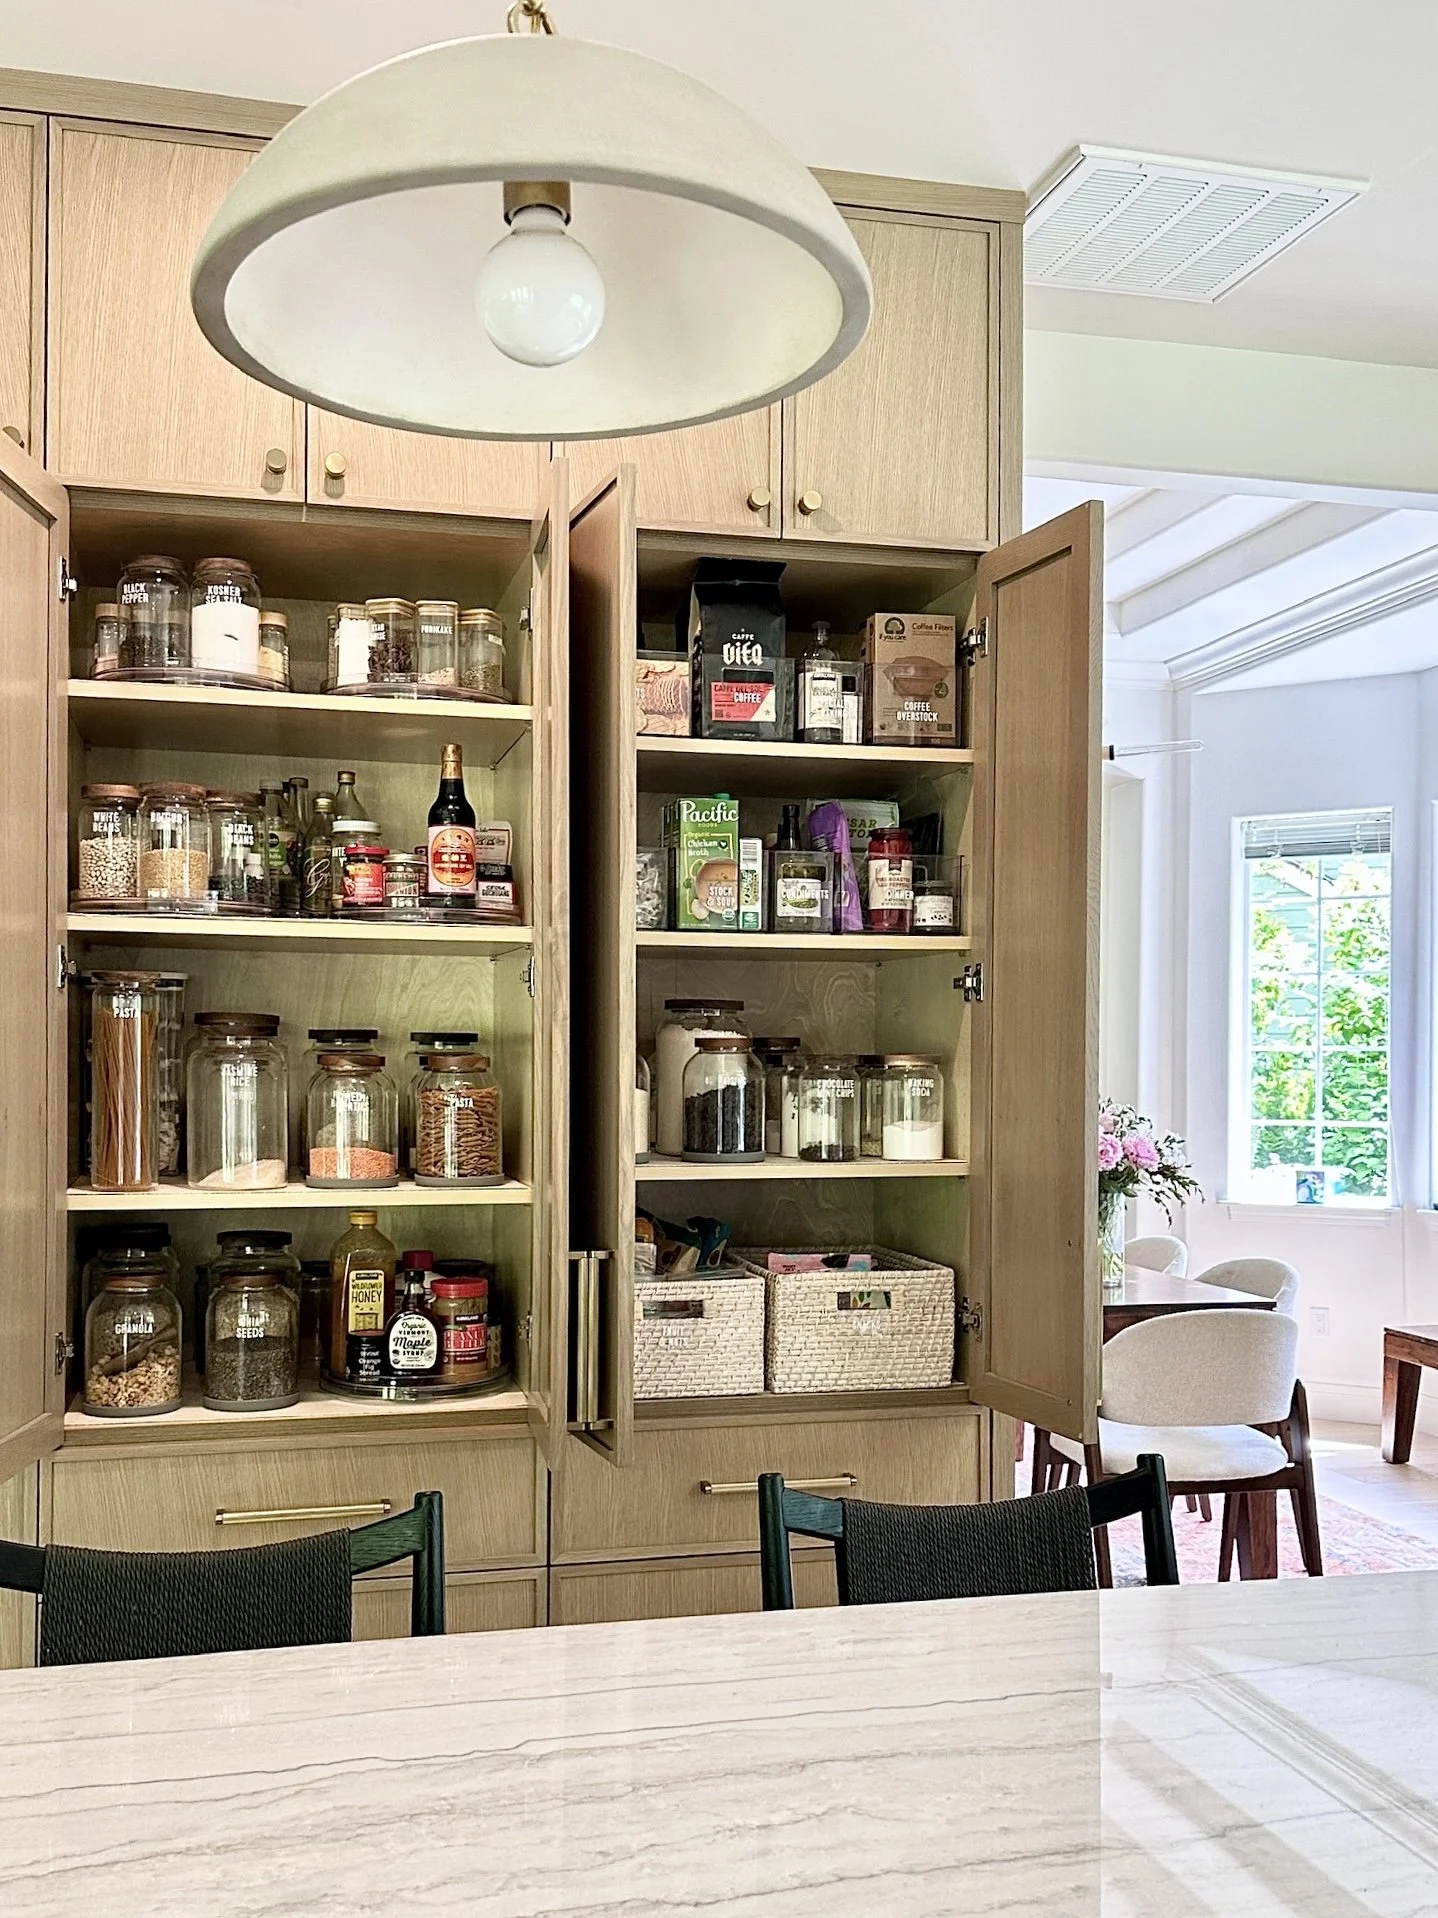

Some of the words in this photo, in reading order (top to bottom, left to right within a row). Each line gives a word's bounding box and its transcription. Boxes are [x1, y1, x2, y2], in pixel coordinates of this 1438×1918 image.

[123, 583, 146, 594] BLACK
[207, 585, 241, 597] KOSHER
[122, 592, 149, 604] PEPPER
[206, 595, 223, 605] SEA
[421, 624, 453, 634] FURIKAKE
[911, 622, 933, 630] Coffee
[934, 623, 954, 631] Filters
[733, 692, 762, 704] COFFEE
[904, 701, 931, 711] COFFEE
[896, 711, 938, 722] OVERSTOCK
[93, 811, 121, 823] WHITE
[680, 801, 740, 824] Pacific
[92, 822, 122, 834] BEANS
[849, 818, 877, 828] SAR
[227, 823, 254, 835] BLACK
[228, 833, 254, 846] BEANS
[687, 838, 718, 848] Chicken
[687, 847, 710, 857] Broth
[709, 886, 734, 897] STOCK
[781, 889, 830, 900] CONDIMENTS
[716, 896, 735, 907] SOUP
[113, 1007, 139, 1019] PASTA
[230, 1076, 250, 1087] RICE
[816, 1079, 855, 1089] CHOCOLATE
[836, 1088, 855, 1099] CHIPS
[911, 1087, 931, 1097] SODA
[450, 1097, 474, 1108] PASTA
[351, 1282, 382, 1290] WILDFLOWER
[351, 1290, 382, 1303] HONEY
[114, 1323, 153, 1335] GRANOLA
[401, 1322, 427, 1331] Organic
[236, 1327, 264, 1339] SEEDS
[392, 1336, 432, 1350] Maple
[358, 1358, 382, 1366] Orange
[358, 1369, 381, 1377] Spread
